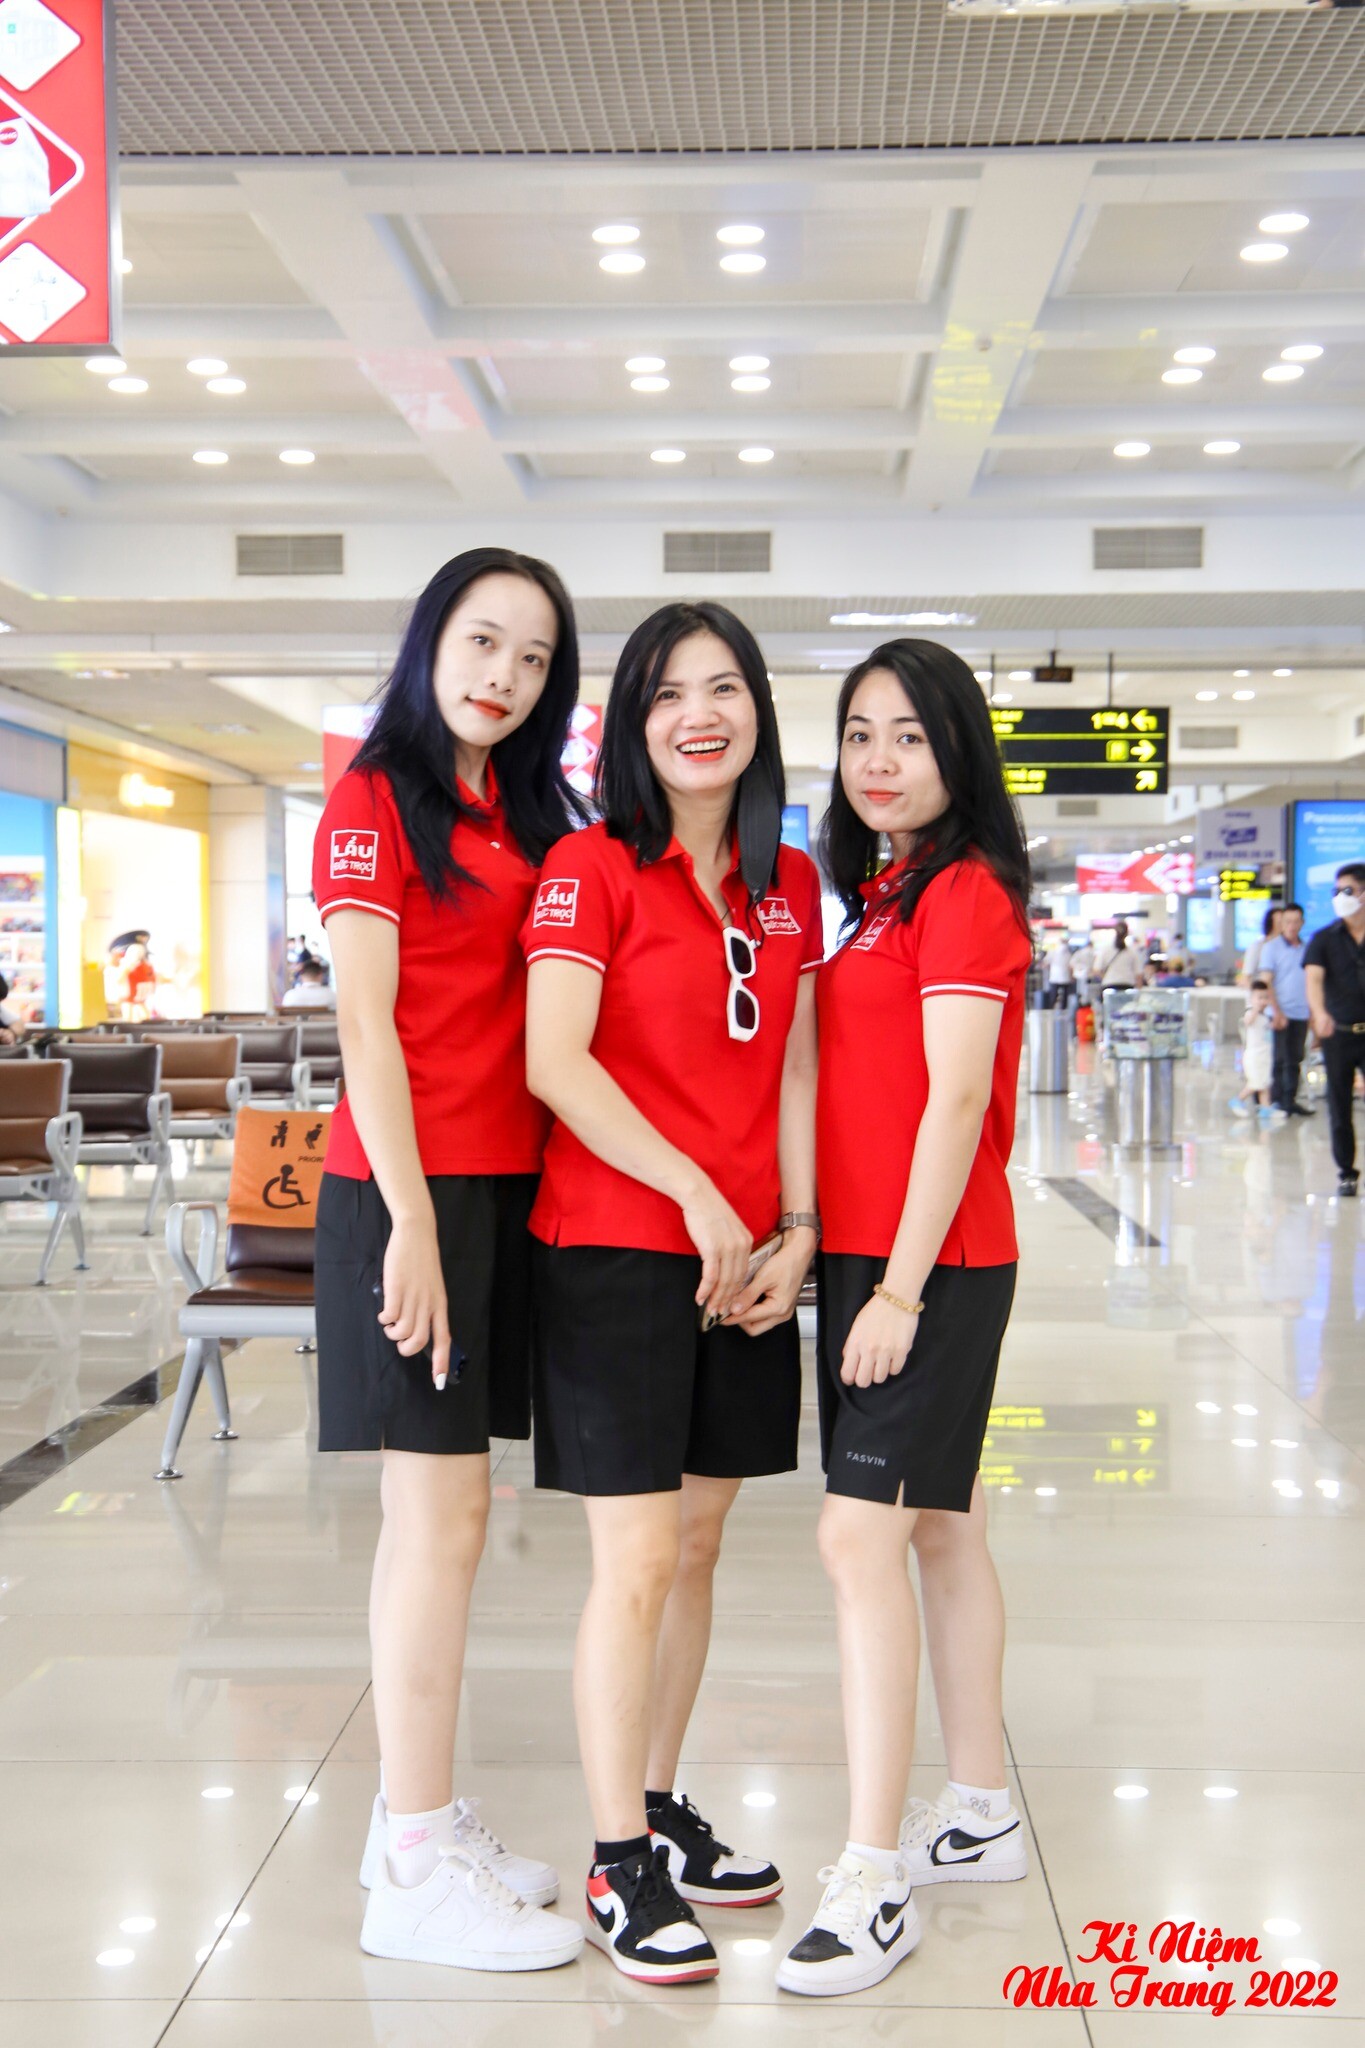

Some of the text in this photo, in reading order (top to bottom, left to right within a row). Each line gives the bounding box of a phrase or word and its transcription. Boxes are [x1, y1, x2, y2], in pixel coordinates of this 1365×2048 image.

[333, 835, 374, 859] LẨU
[538, 884, 574, 907] LẨU
[846, 1451, 887, 1467] FASVIN
[402, 1828, 430, 1841] NIKE
